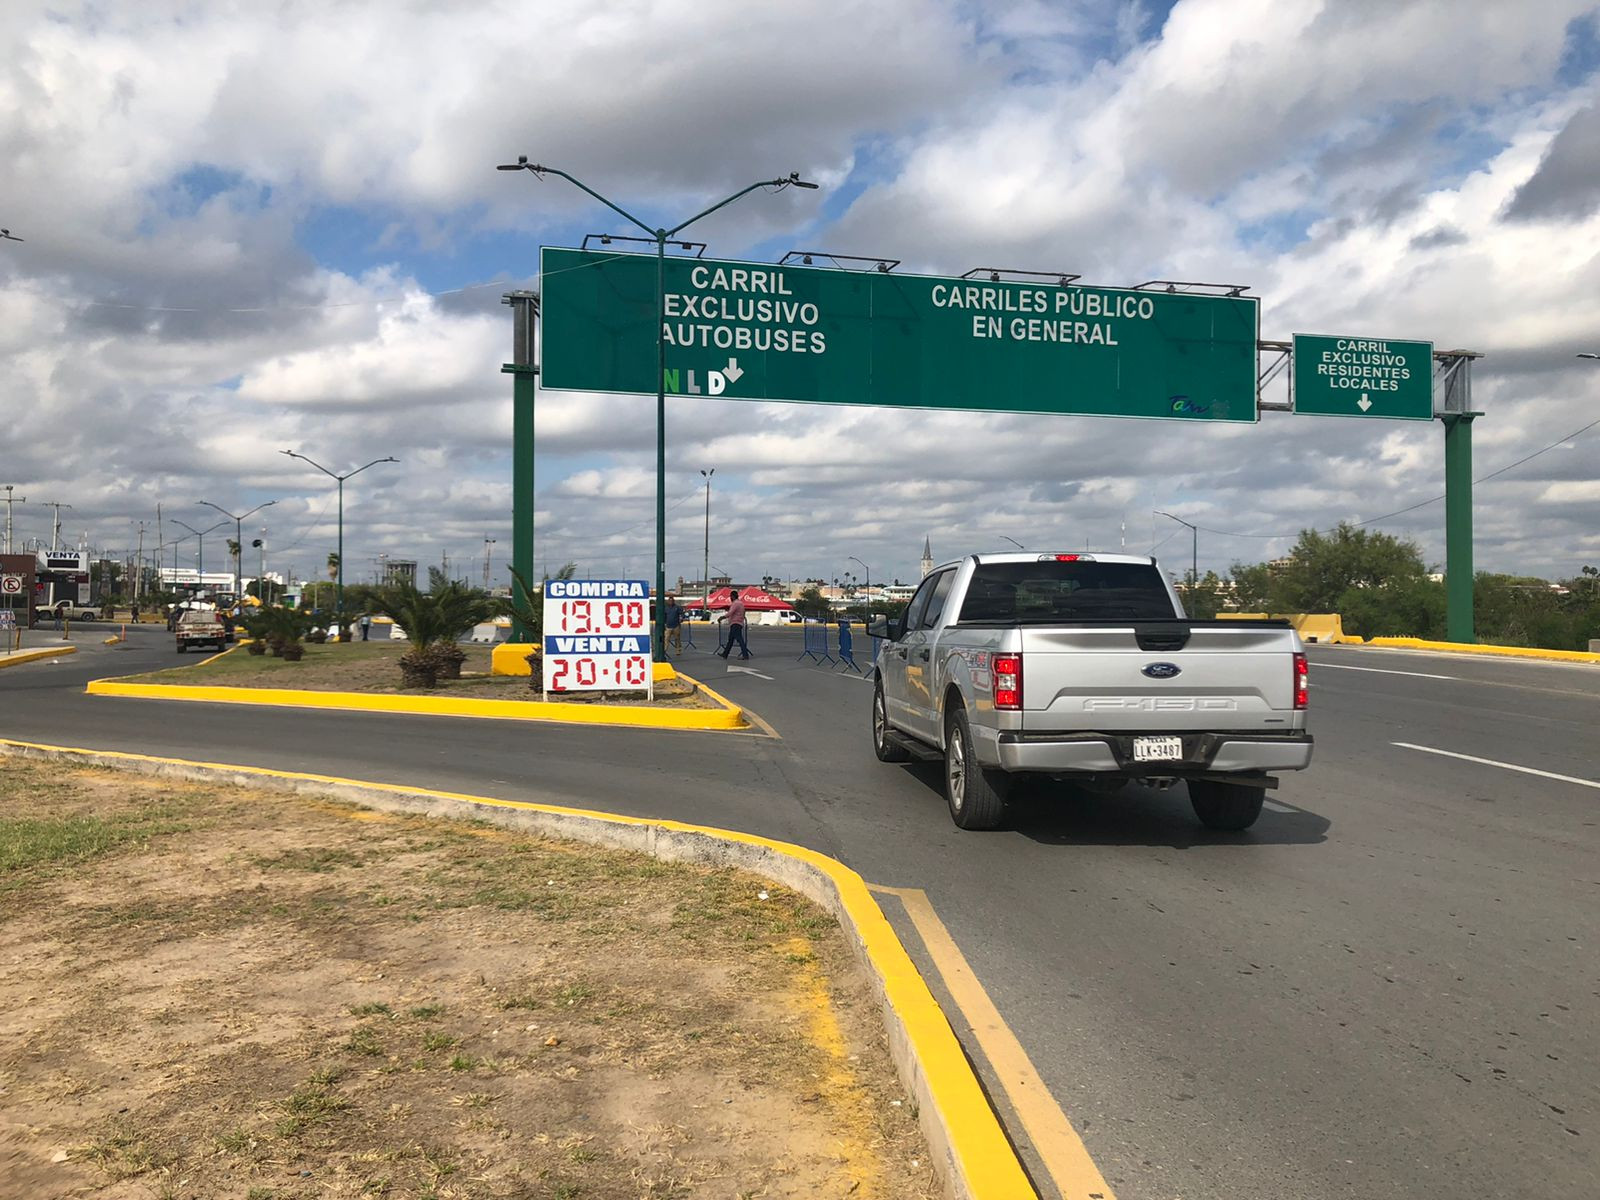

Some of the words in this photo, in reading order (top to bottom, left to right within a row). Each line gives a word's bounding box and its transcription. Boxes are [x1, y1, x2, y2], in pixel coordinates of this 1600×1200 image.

[691, 266, 793, 295] CARRIL
[664, 293, 819, 325] EXCLUSIVO
[931, 284, 1048, 313] CARRILES
[1055, 289, 1154, 319] PÚBLICO
[657, 322, 826, 354] AUTOBUSES
[972, 315, 1002, 339] EN
[1010, 317, 1119, 346] GENERAL
[1336, 339, 1391, 354] CARRIL
[1322, 351, 1406, 367] EXCLUSIVO
[1317, 363, 1411, 380] RESIDENTES
[1330, 377, 1399, 392] LOCALES
[45, 551, 81, 560] VENTA
[550, 582, 644, 597] COMPRA
[561, 600, 643, 634] 19.00
[555, 637, 641, 653] VENTA
